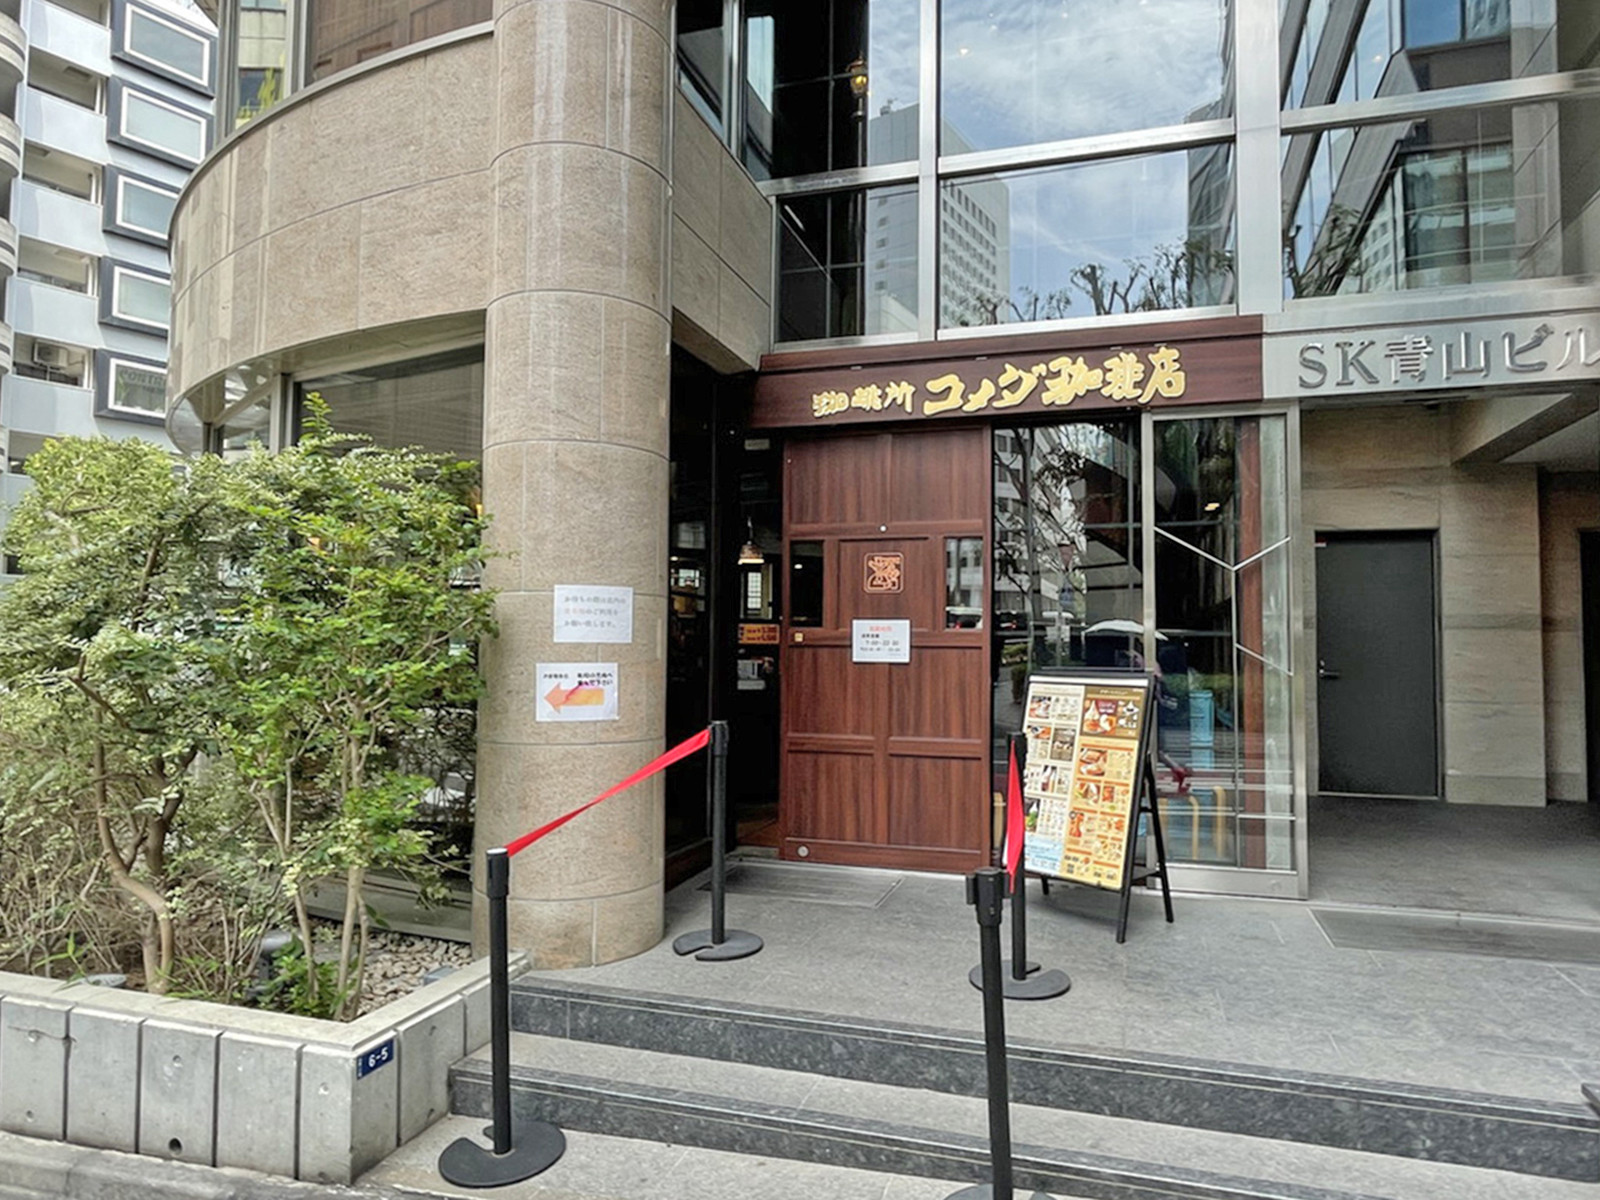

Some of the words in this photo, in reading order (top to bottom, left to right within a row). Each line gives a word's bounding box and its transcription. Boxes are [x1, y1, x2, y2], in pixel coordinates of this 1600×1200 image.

[1299, 323, 1600, 389] SK青山ビル
[368, 1046, 388, 1068] 6-5
